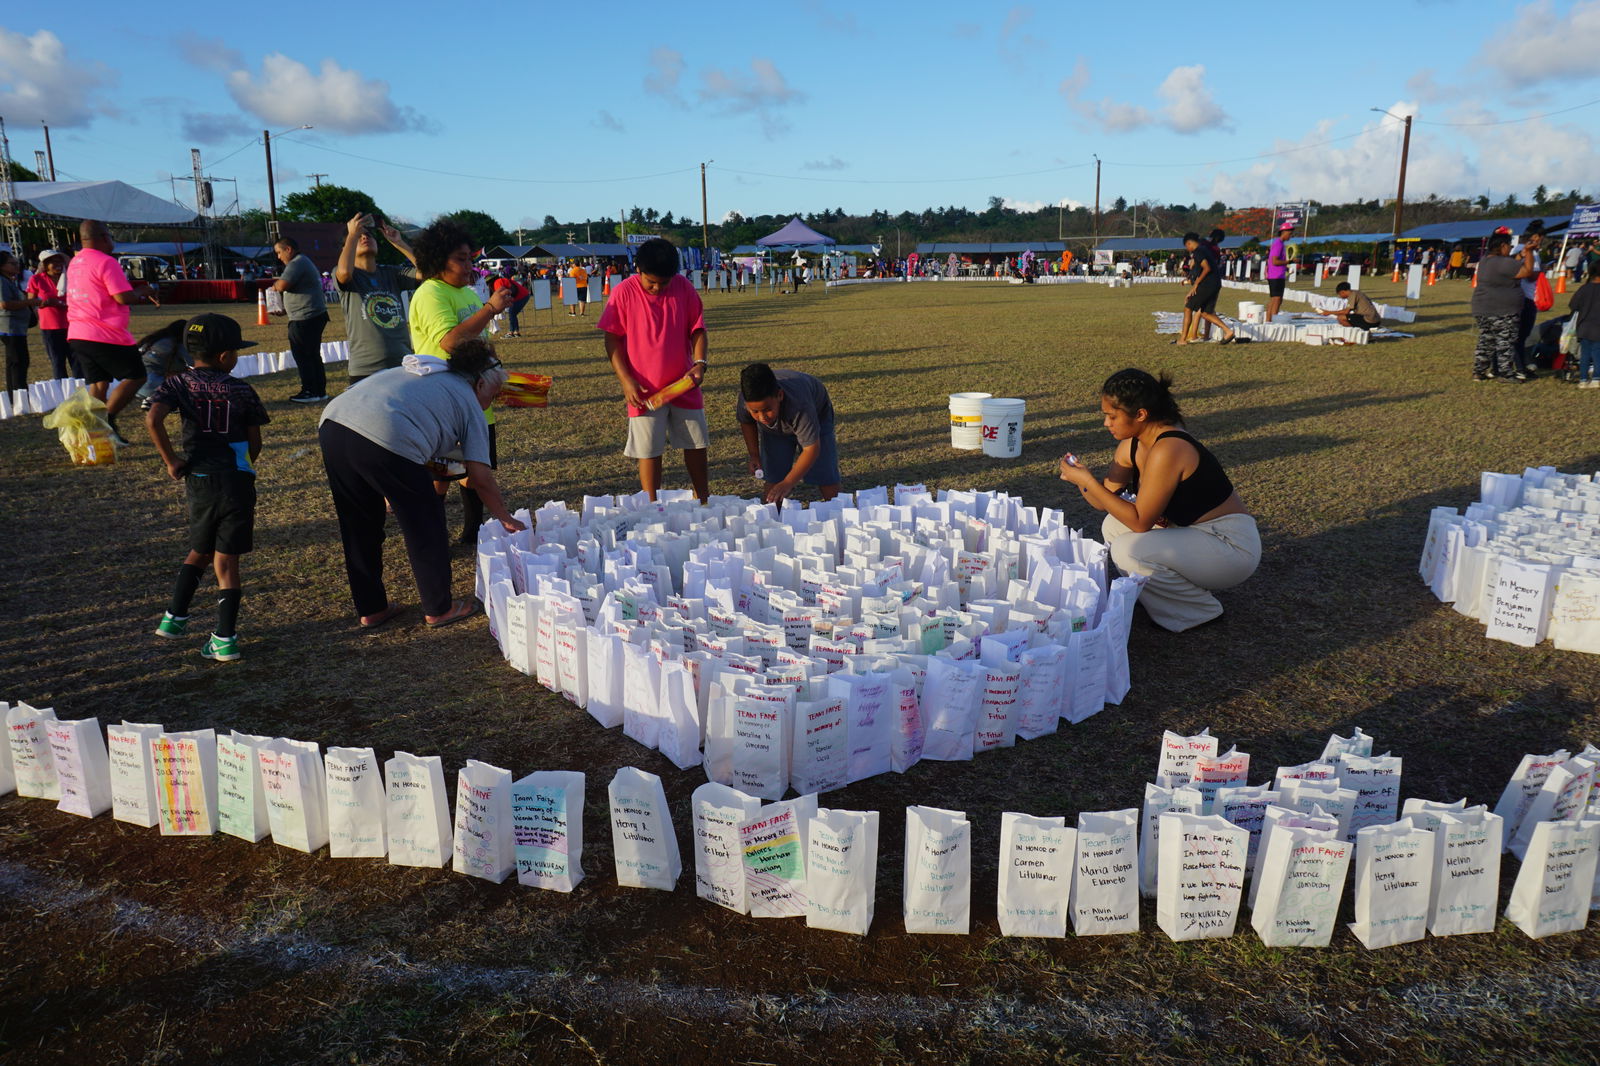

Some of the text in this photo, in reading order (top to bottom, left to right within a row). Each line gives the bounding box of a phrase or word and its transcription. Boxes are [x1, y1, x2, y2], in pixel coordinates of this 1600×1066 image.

[1499, 578, 1540, 598] In Memory
[1496, 596, 1533, 614] Benjamin
[1496, 608, 1526, 620] Joseph
[1494, 617, 1537, 634] Delos Reyes
[736, 710, 757, 720] TEAM
[808, 712, 825, 721] TEAM
[1164, 738, 1184, 750] Team
[1166, 752, 1176, 760] In
[1196, 762, 1216, 772] Team
[1346, 768, 1368, 776] Team
[514, 794, 533, 802] Team
[742, 821, 768, 835] TEAM
[697, 828, 723, 842] Carmen
[1018, 834, 1036, 845] Team
[1082, 838, 1108, 850] Team
[932, 848, 949, 857] Honor
[1093, 850, 1114, 858] HONOR
[1184, 850, 1194, 858] In
[1548, 850, 1578, 860] IN HONOR
[1014, 858, 1045, 868] Carmen
[1446, 856, 1472, 867] Melvin
[1080, 866, 1109, 878] Maria
[1374, 871, 1396, 883] Henry
[1198, 891, 1222, 902] fighting
[1092, 907, 1112, 915] Alvin
